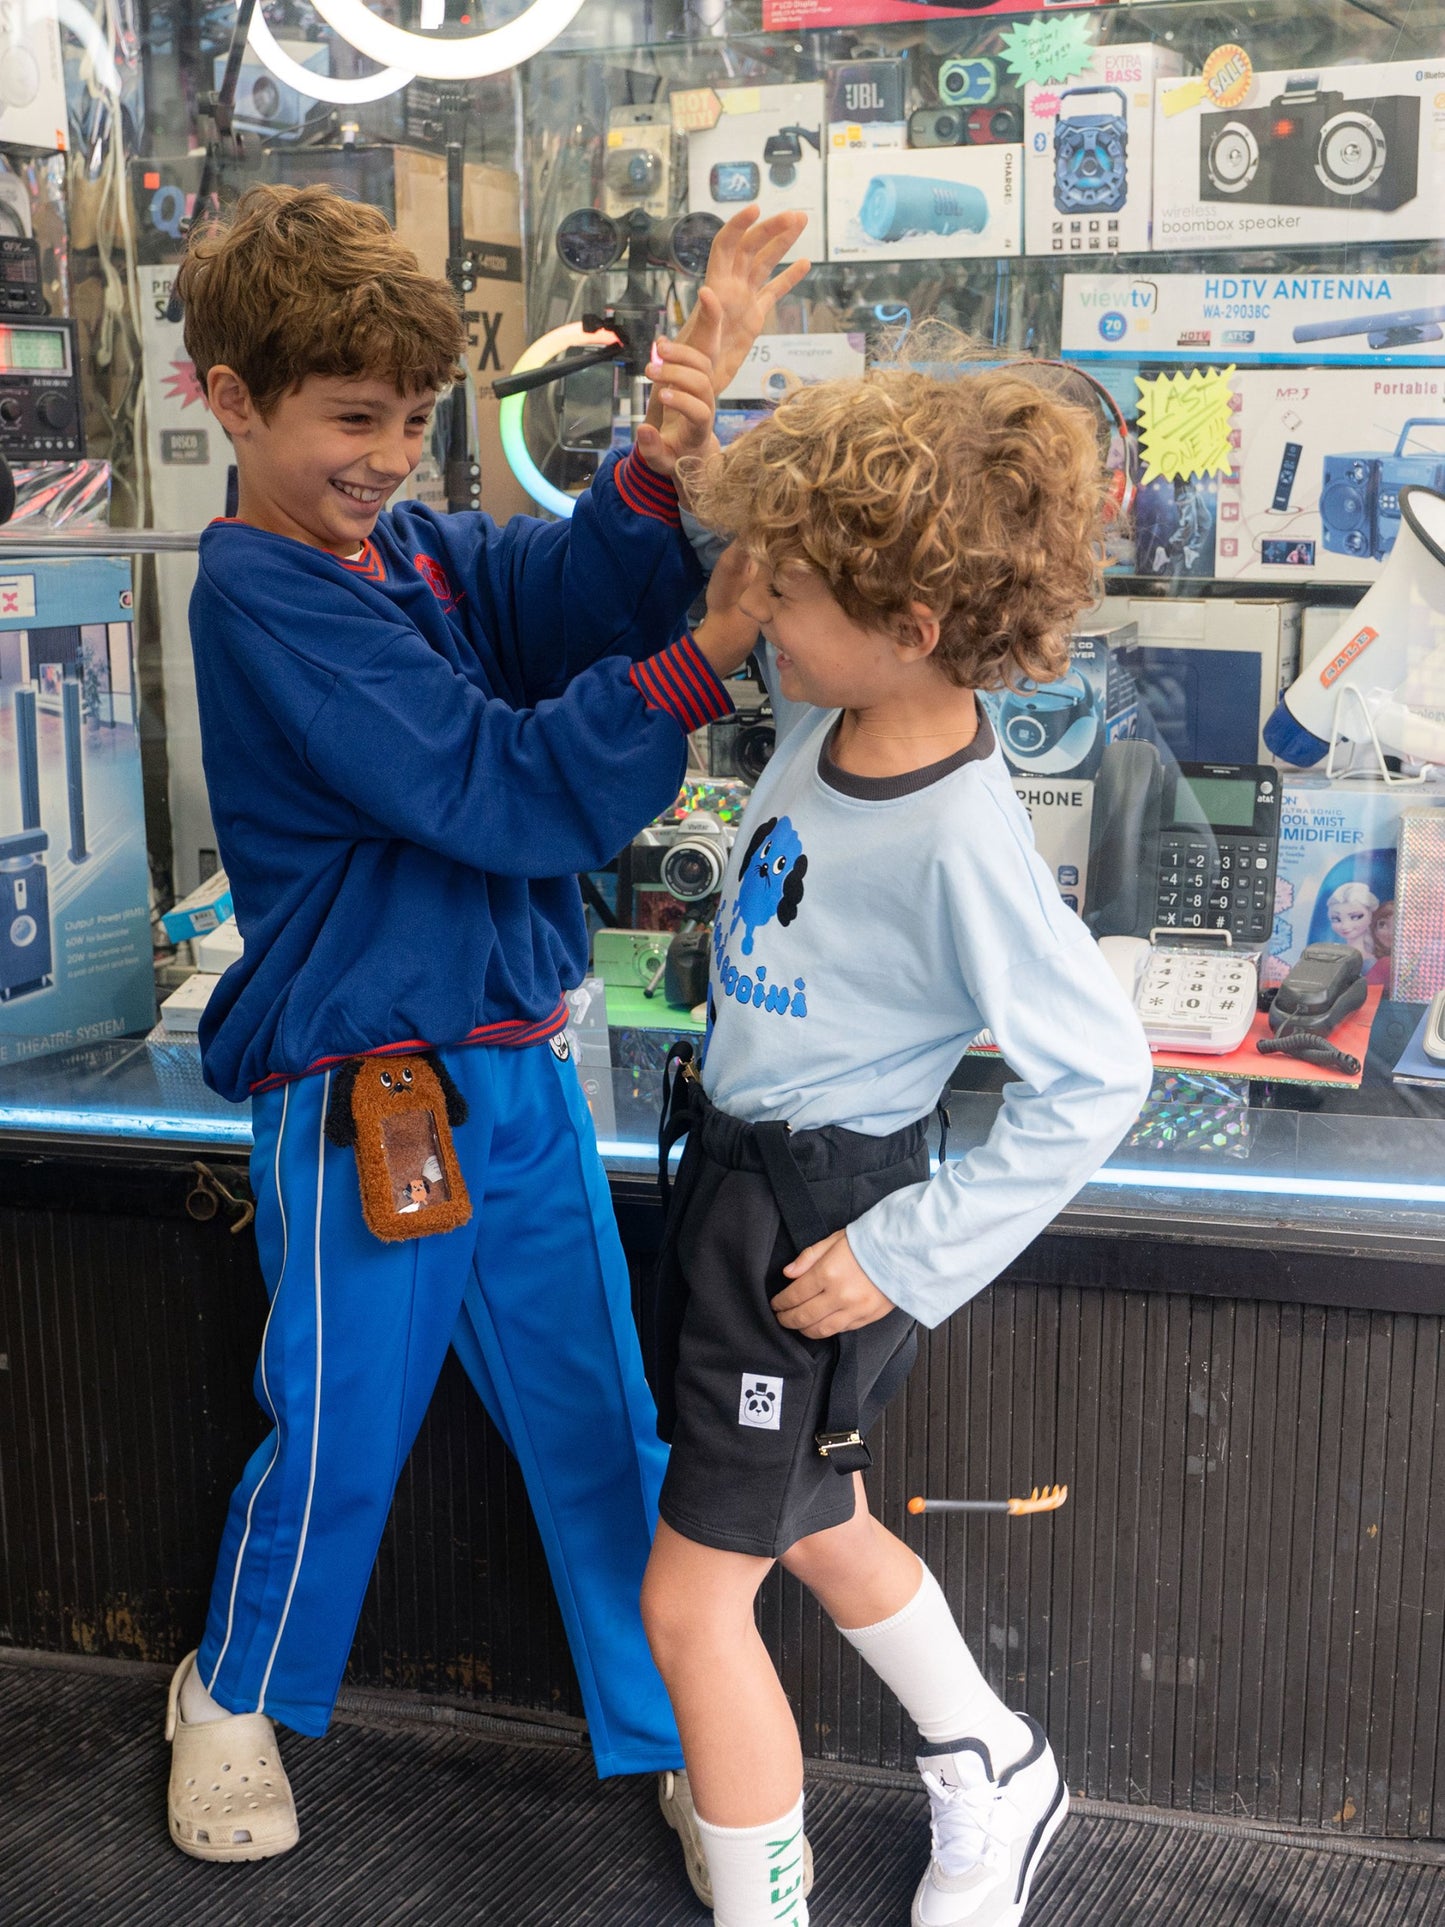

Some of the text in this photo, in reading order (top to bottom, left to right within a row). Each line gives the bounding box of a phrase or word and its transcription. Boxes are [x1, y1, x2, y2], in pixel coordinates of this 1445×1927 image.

[1105, 55, 1142, 70] EXTRA
[1105, 68, 1142, 84] BASS
[1207, 53, 1248, 99] SALE
[845, 82, 884, 110] JBL
[1161, 204, 1217, 218] wireless
[1162, 215, 1302, 234] boombox speaker
[1205, 279, 1393, 300] HDTV ANTENNA
[1105, 319, 1123, 332] 70
[1374, 381, 1438, 395] Portable
[1150, 380, 1222, 431] LAST
[1325, 632, 1369, 679] SALE
[1016, 789, 1084, 808] PHONE
[1313, 816, 1346, 827] MIST
[1172, 853, 1178, 866] 1
[1196, 855, 1205, 868] 2
[1222, 856, 1231, 869] 3
[1169, 873, 1229, 889] 4 5 6
[1169, 893, 1178, 905] 7
[1193, 894, 1202, 907] 8
[1220, 896, 1228, 909] 9
[64, 917, 95, 932] Output
[1192, 913, 1201, 927] 0
[1190, 983, 1203, 992] 8
[16, 1028, 73, 1056] THEATRE
[77, 1017, 126, 1040] SYSTEM
